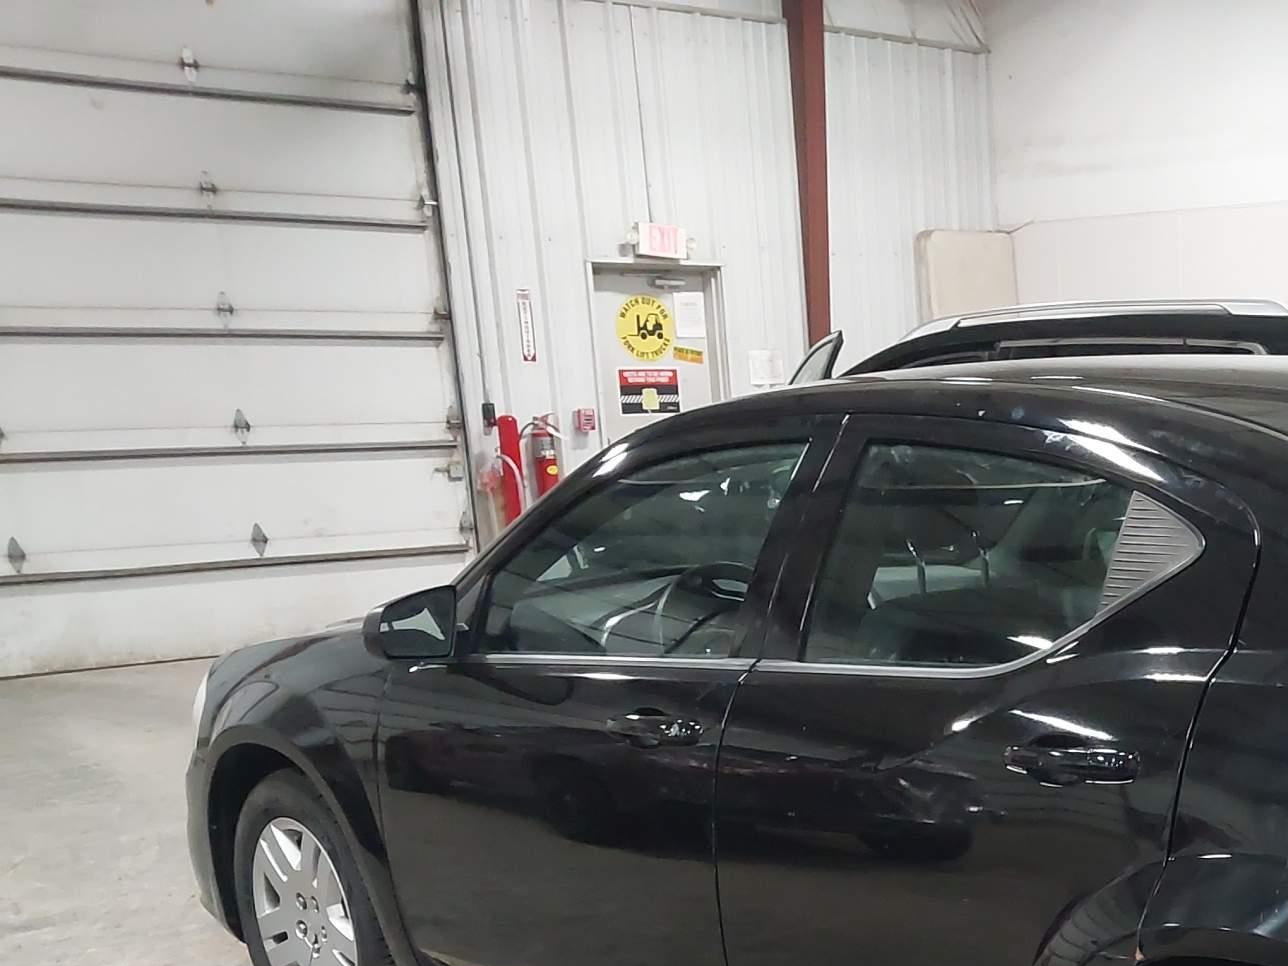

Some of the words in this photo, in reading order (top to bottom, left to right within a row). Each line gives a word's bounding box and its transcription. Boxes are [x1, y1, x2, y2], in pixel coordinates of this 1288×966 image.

[648, 224, 680, 254] EXIT
[619, 296, 640, 319] WATCH
[641, 296, 656, 307] OUT
[655, 304, 668, 320] FOR
[621, 336, 636, 354] FORK
[635, 350, 650, 359] LIFT
